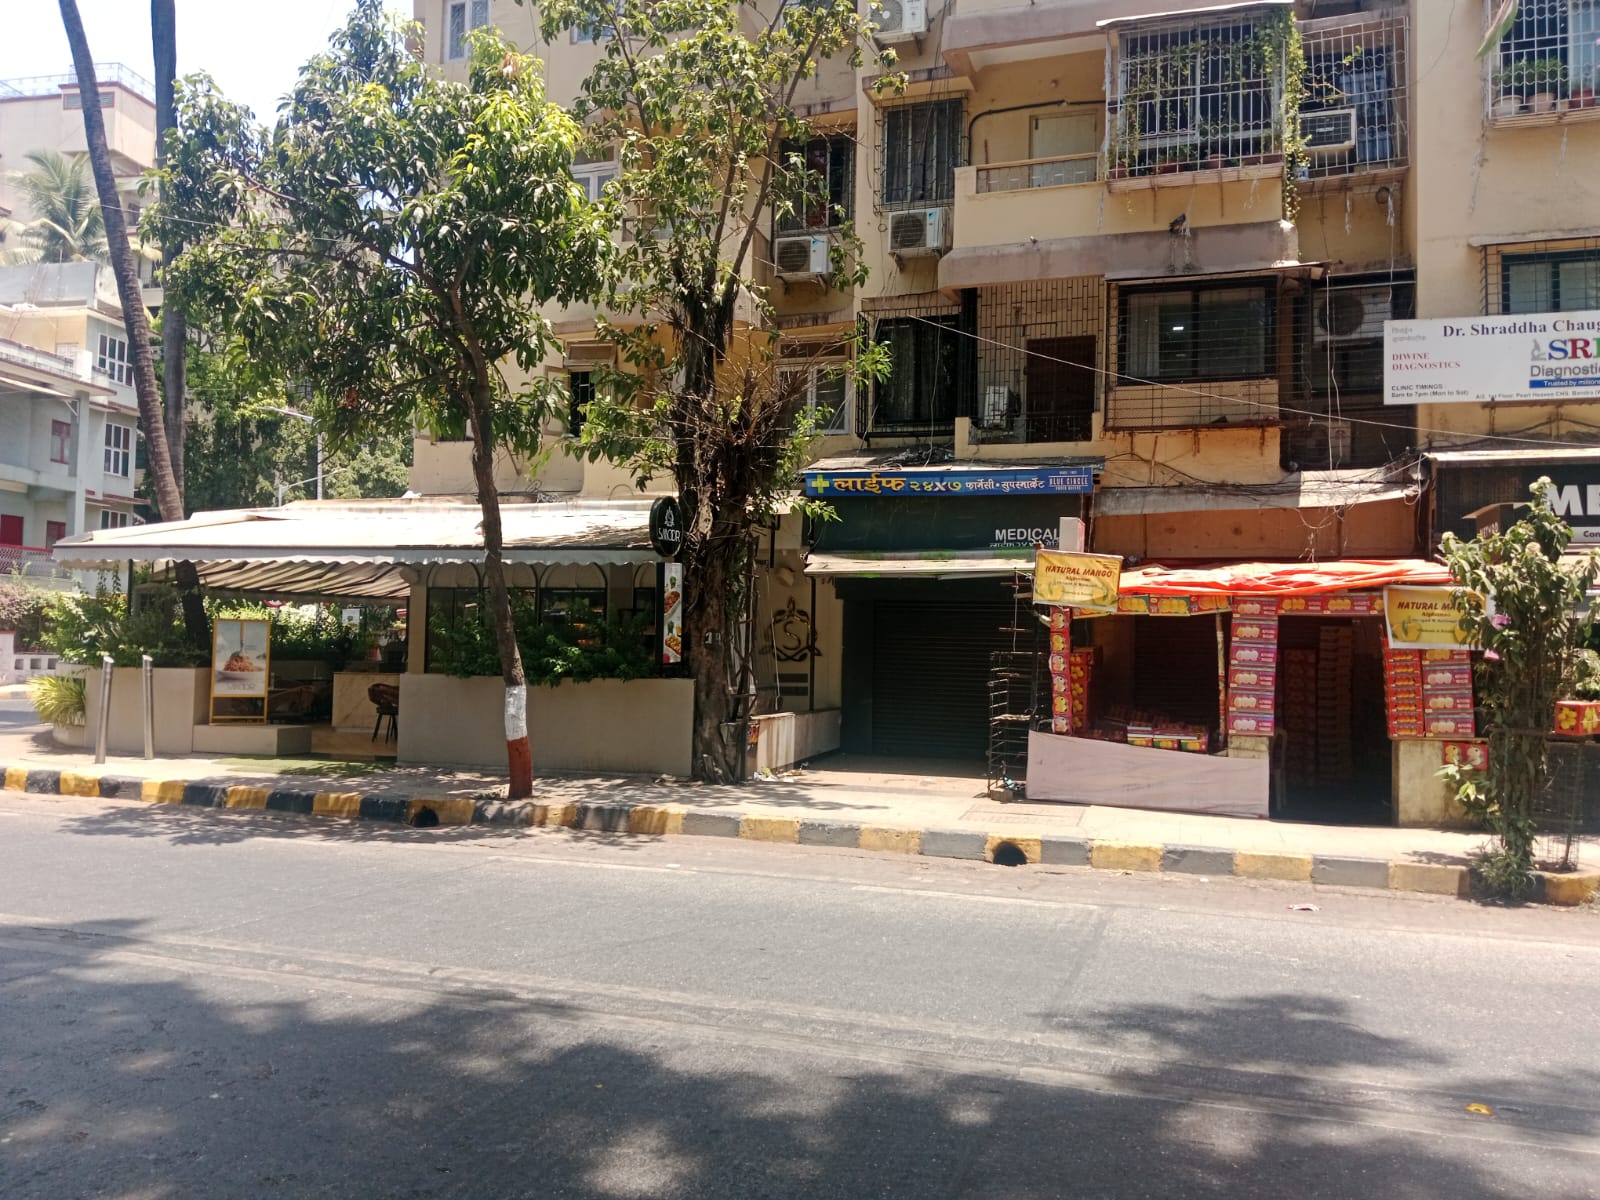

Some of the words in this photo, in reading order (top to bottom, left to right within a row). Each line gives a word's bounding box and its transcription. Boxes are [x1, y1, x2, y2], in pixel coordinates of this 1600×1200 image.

[1443, 325, 1465, 337] Dr.
[1470, 322, 1547, 335] Shraddha
[1392, 361, 1461, 371] DIAGNOSTICS
[832, 472, 906, 494] लाईफ
[995, 528, 1059, 541] MEDICAL
[1045, 566, 1080, 574] NATURAL
[1083, 569, 1113, 578] MANGO
[1397, 601, 1438, 610] NATURAL
